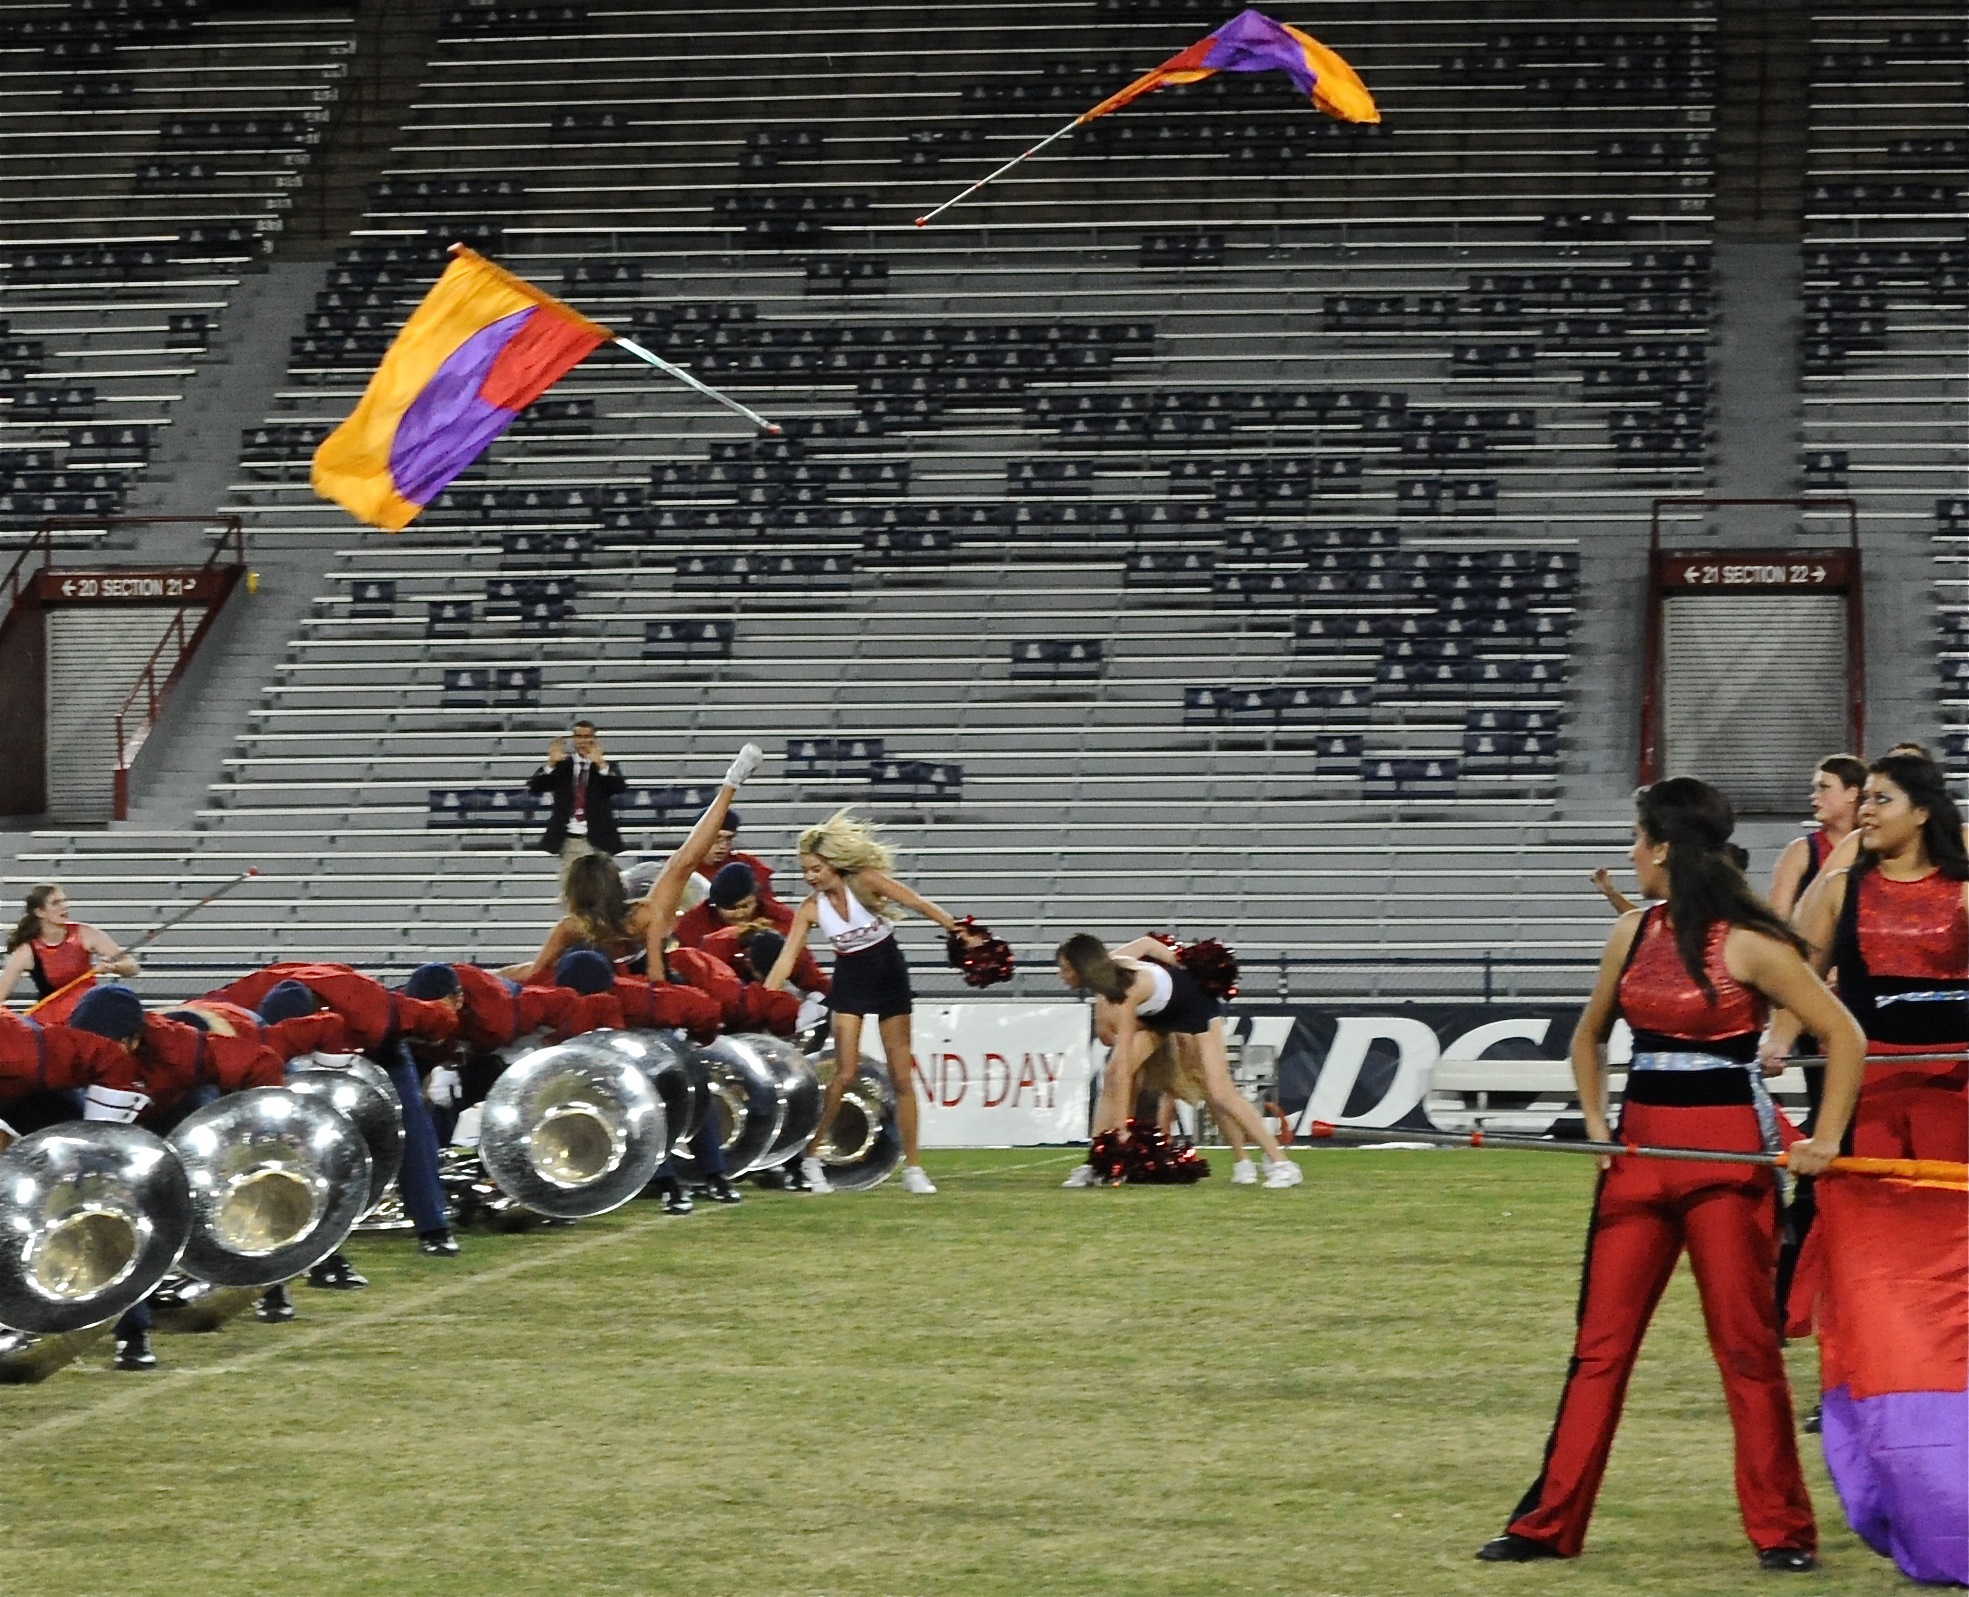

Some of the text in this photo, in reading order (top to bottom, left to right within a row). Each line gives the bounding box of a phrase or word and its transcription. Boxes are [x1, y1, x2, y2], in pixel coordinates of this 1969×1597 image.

[1701, 565, 1809, 583] 21 SECTION 22
[77, 579, 183, 597] 20 SECTION 21
[982, 1053, 1065, 1109] DAY
